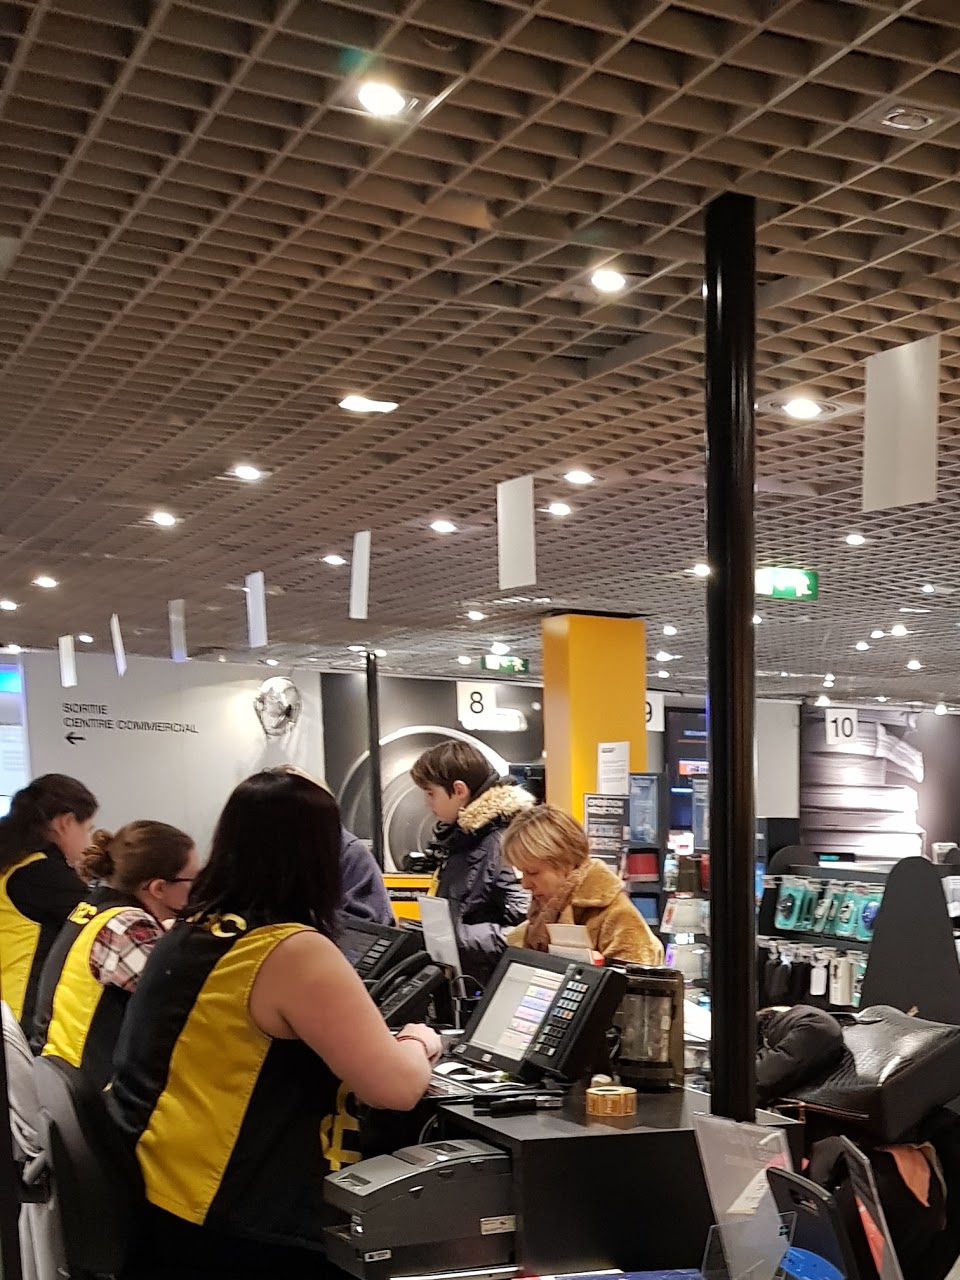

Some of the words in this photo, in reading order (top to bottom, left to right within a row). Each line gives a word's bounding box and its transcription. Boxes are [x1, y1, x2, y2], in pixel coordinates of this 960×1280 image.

[62, 702, 108, 714] SORTIE
[469, 691, 484, 713] 8
[63, 717, 114, 729] CENTRE
[116, 719, 199, 734] COMMERCIAL
[831, 716, 854, 738] 10
